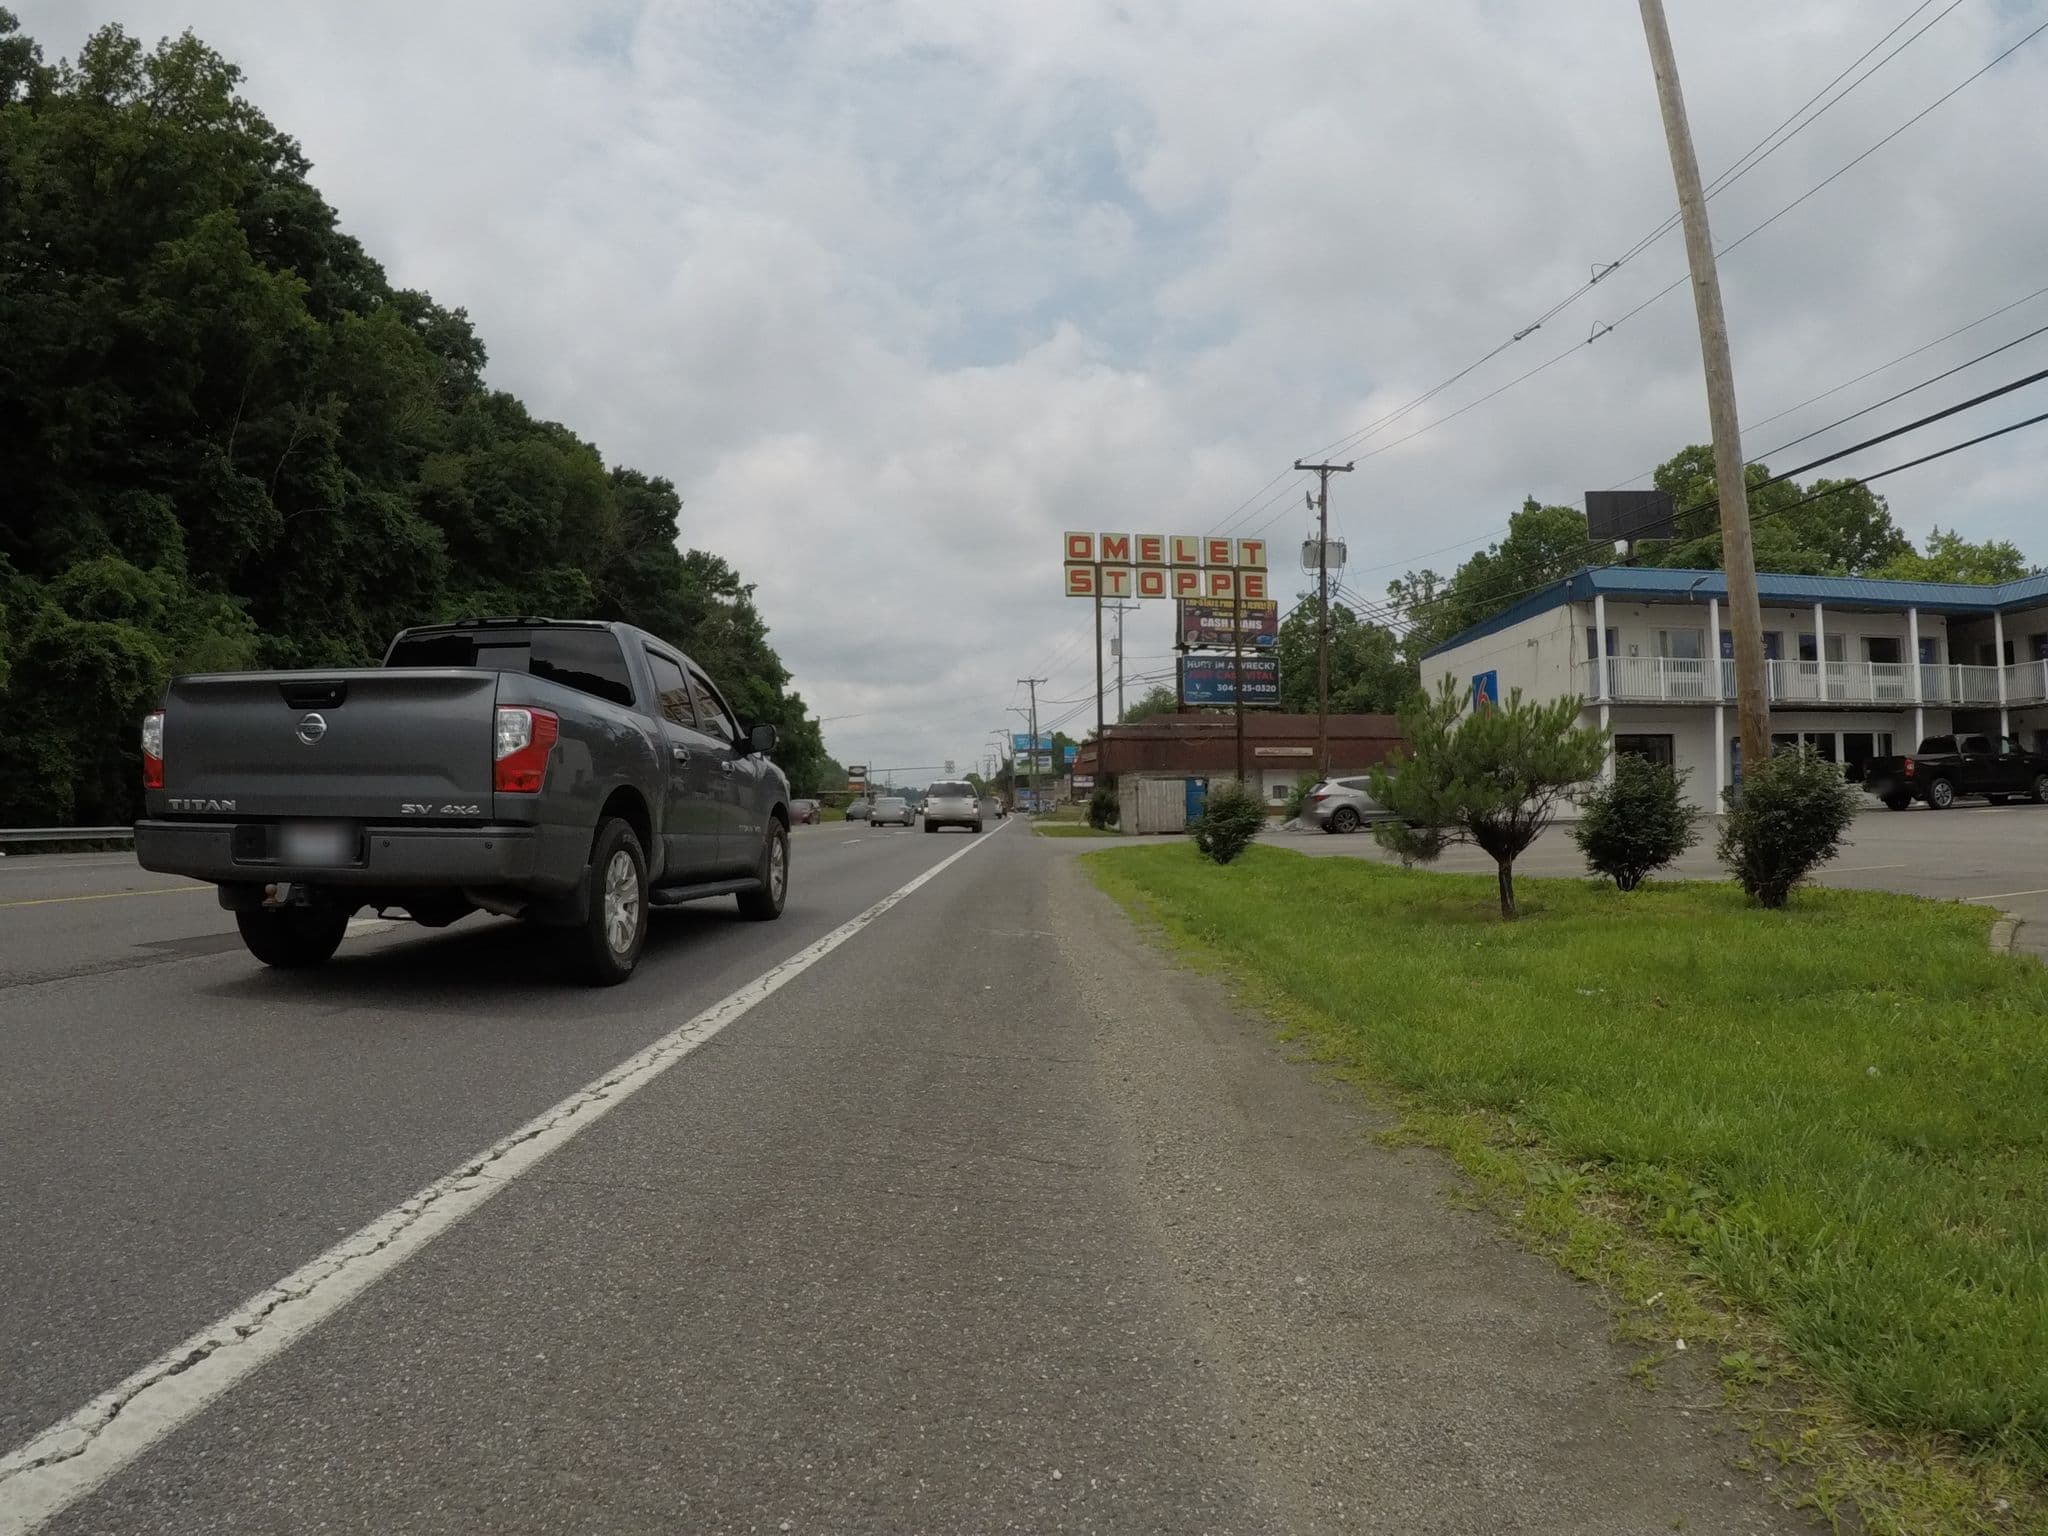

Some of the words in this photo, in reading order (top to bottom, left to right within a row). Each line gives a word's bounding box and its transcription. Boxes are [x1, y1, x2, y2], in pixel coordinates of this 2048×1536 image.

[1069, 535, 1262, 565] OMELET
[1070, 569, 1263, 598] STOPPE
[1200, 617, 1229, 628] CASH
[168, 798, 237, 812] TITAN
[400, 803, 433, 814] SV
